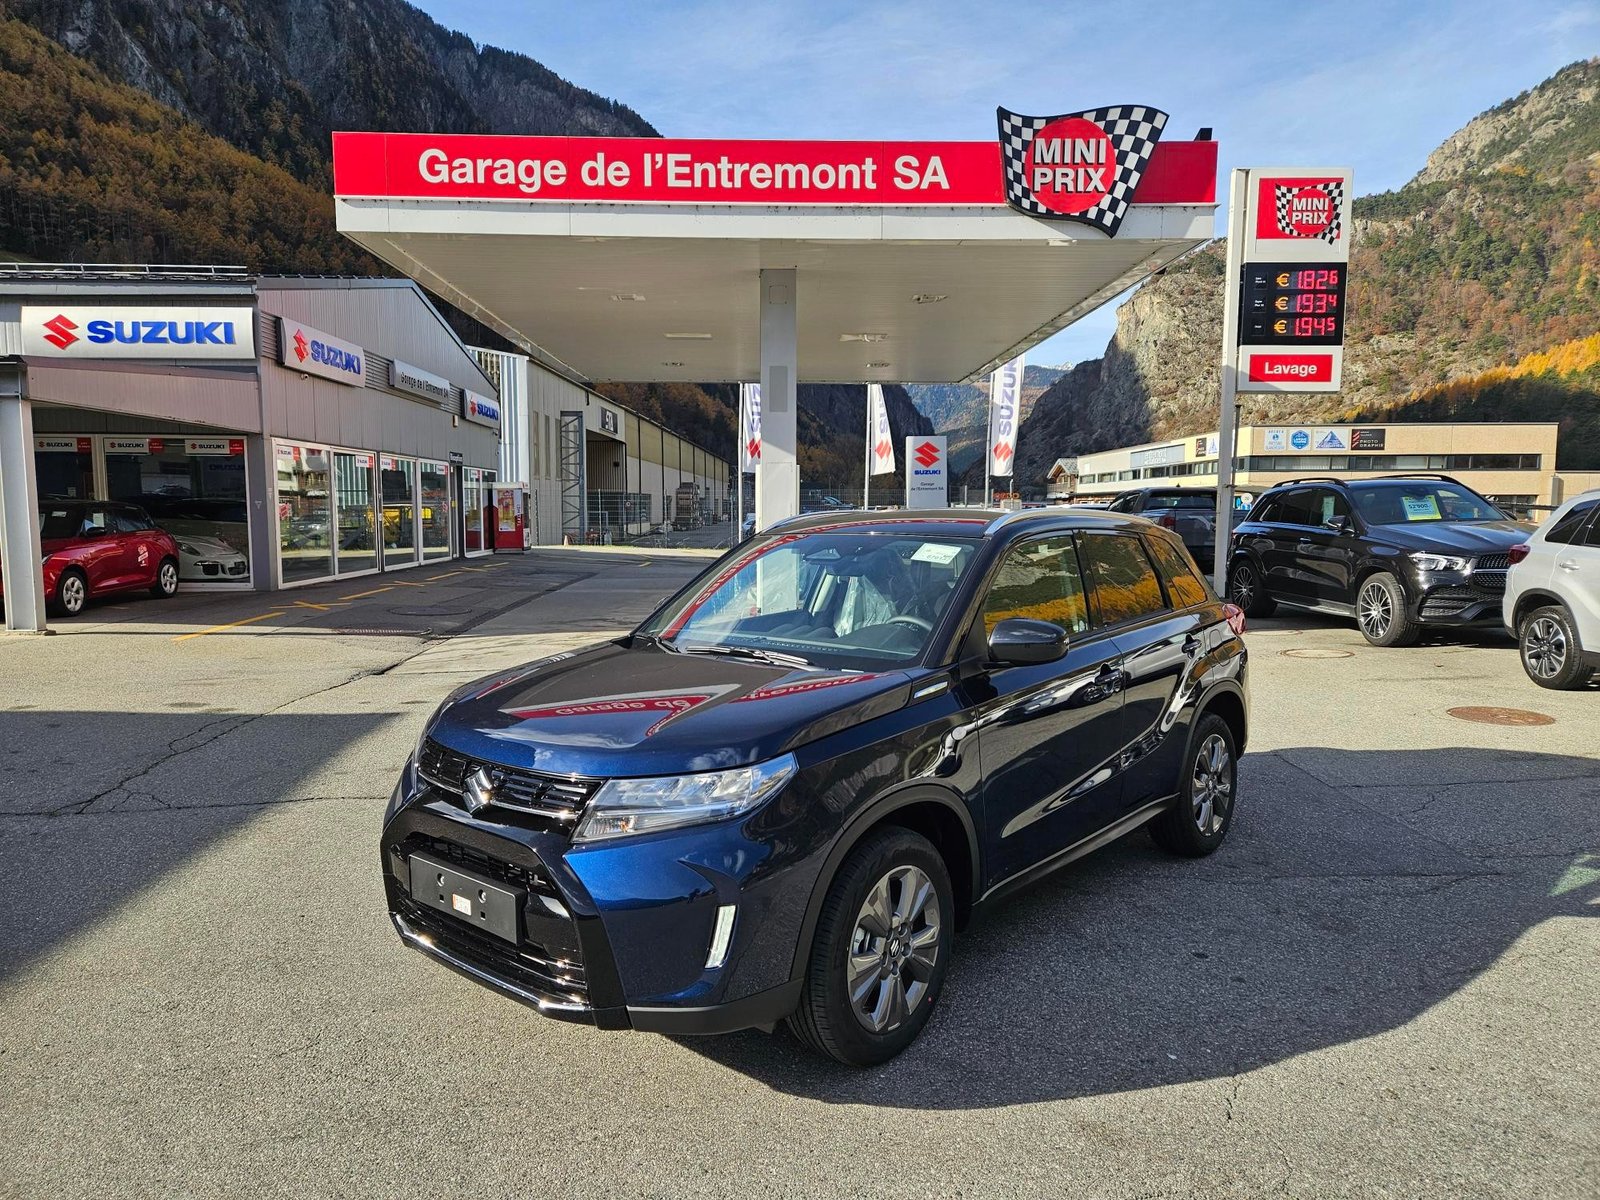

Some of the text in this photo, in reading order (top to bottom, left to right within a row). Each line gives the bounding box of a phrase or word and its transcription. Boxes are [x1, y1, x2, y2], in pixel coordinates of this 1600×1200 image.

[1033, 138, 1107, 165] MINI
[418, 148, 950, 193] Garage de l'Entremont SA
[1033, 167, 1106, 193] PRIX
[1292, 197, 1329, 211] MINI
[1291, 211, 1328, 225] PRIX
[87, 320, 236, 345] SUZUKI
[310, 340, 361, 375] SUZUKI
[1264, 362, 1317, 377] Lavage
[999, 357, 1018, 437] SUZUK
[477, 403, 499, 421] SUZUKI
